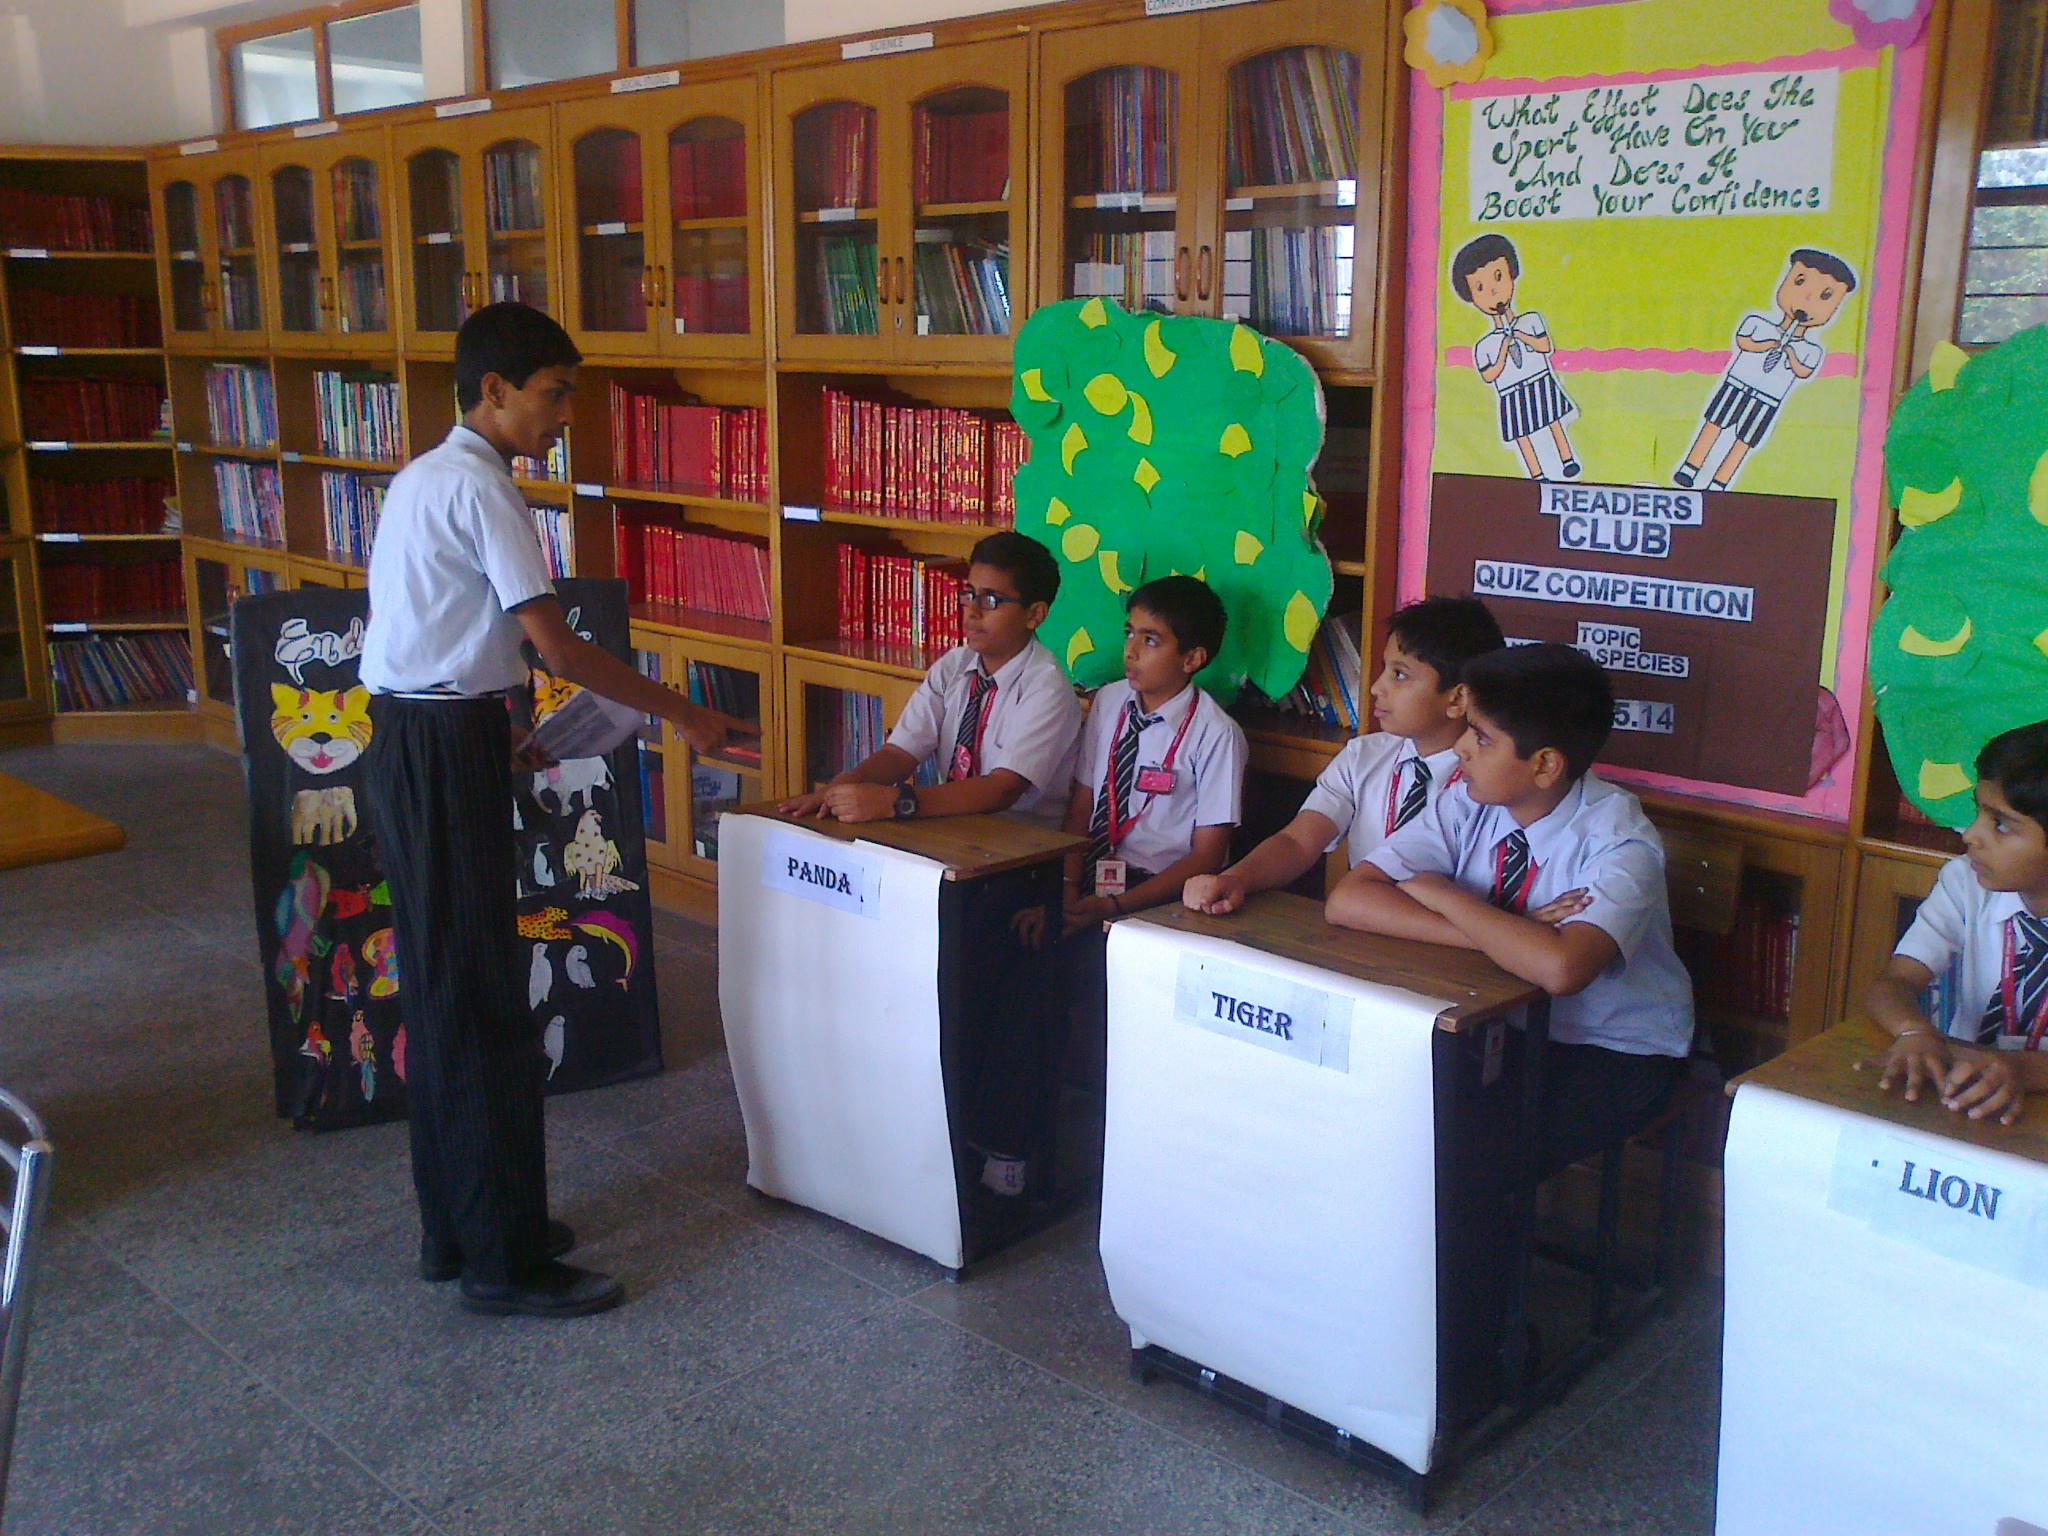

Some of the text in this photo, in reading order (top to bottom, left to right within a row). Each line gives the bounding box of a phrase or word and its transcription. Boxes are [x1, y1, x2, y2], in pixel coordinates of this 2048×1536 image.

[1482, 75, 1814, 134] What Effect Does The
[1492, 113, 1800, 177] Sport Have On You
[1515, 145, 1737, 192] And Does It
[1478, 179, 1820, 222] Boost Your Confidence
[1551, 488, 1692, 520] READERS
[1562, 516, 1668, 554] CLUB
[1476, 564, 1749, 618] QUIZ COMPETITION
[1580, 627, 1640, 649] TOPIC
[1596, 649, 1686, 674] SPECIES
[787, 856, 852, 896] PANDA
[1211, 991, 1293, 1041] TIGER
[1899, 1160, 2003, 1221] LION
